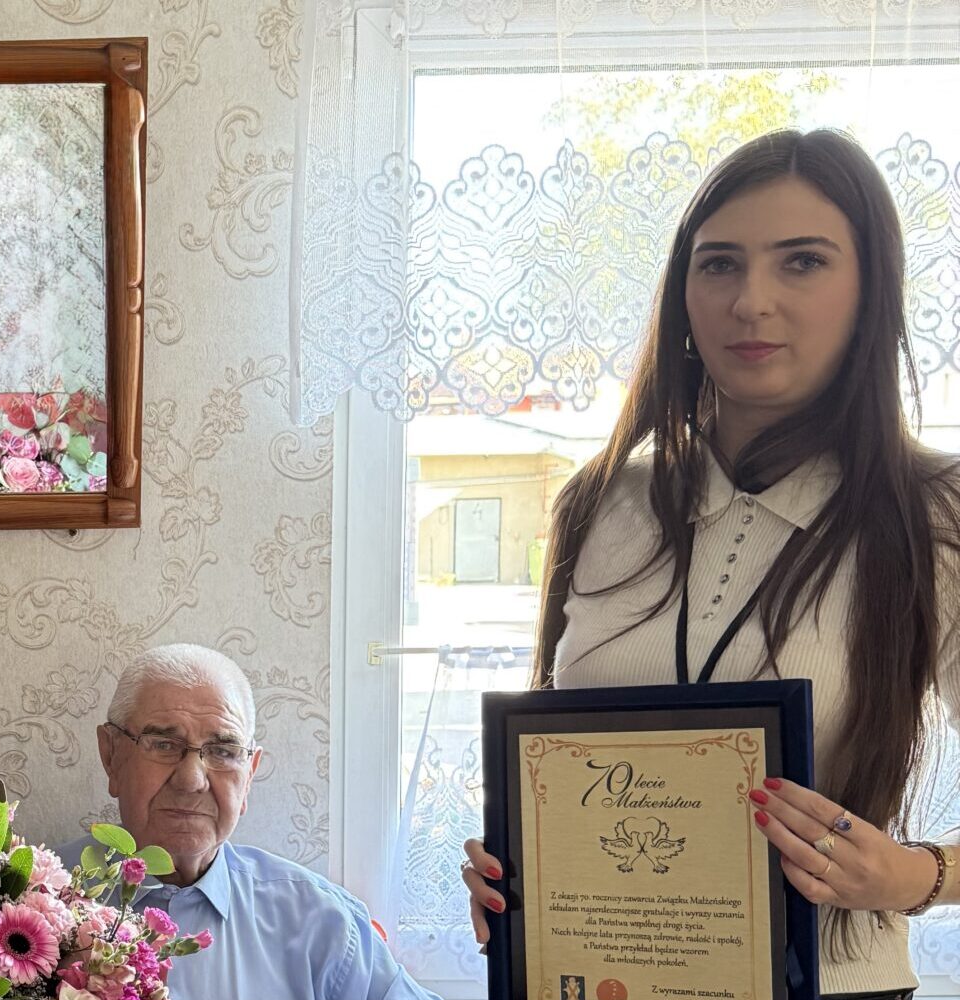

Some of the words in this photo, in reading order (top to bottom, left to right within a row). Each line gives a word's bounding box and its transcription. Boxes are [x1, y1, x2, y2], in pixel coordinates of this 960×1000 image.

[581, 759, 633, 807] 70
[634, 773, 666, 789] lecie
[601, 791, 703, 809] Małżeństwa
[550, 891, 556, 900] Z
[558, 891, 578, 902] okazji
[592, 894, 621, 904] rocznicy
[623, 895, 655, 904] zawarcia
[656, 895, 688, 906] Związku
[690, 895, 742, 908] Małżeńskiego
[549, 903, 579, 912] składam
[580, 904, 641, 916] najserdeczniejsze
[642, 907, 679, 918] gratulacje
[685, 910, 712, 920] wyrazy
[713, 911, 745, 919] uznania
[585, 915, 597, 925] dla
[598, 917, 628, 927] Państwa
[629, 919, 661, 930] wspólnej
[663, 920, 683, 931] drogi
[551, 927, 571, 936] Niech
[573, 928, 598, 939] kolejne
[599, 929, 613, 938] lata
[614, 931, 652, 942] przynoszą
[653, 932, 684, 943] zdrowie,
[686, 934, 711, 943] radość
[717, 935, 744, 947] spokój,
[589, 942, 619, 951] Państwa
[620, 943, 653, 954] przykład
[654, 944, 679, 955] będzie
[680, 948, 709, 956] wzorem
[603, 954, 616, 963] dla
[617, 955, 655, 967] młodszych
[652, 984, 658, 994] Z
[659, 988, 696, 997] wyrazami
[697, 988, 735, 999] szacunku
